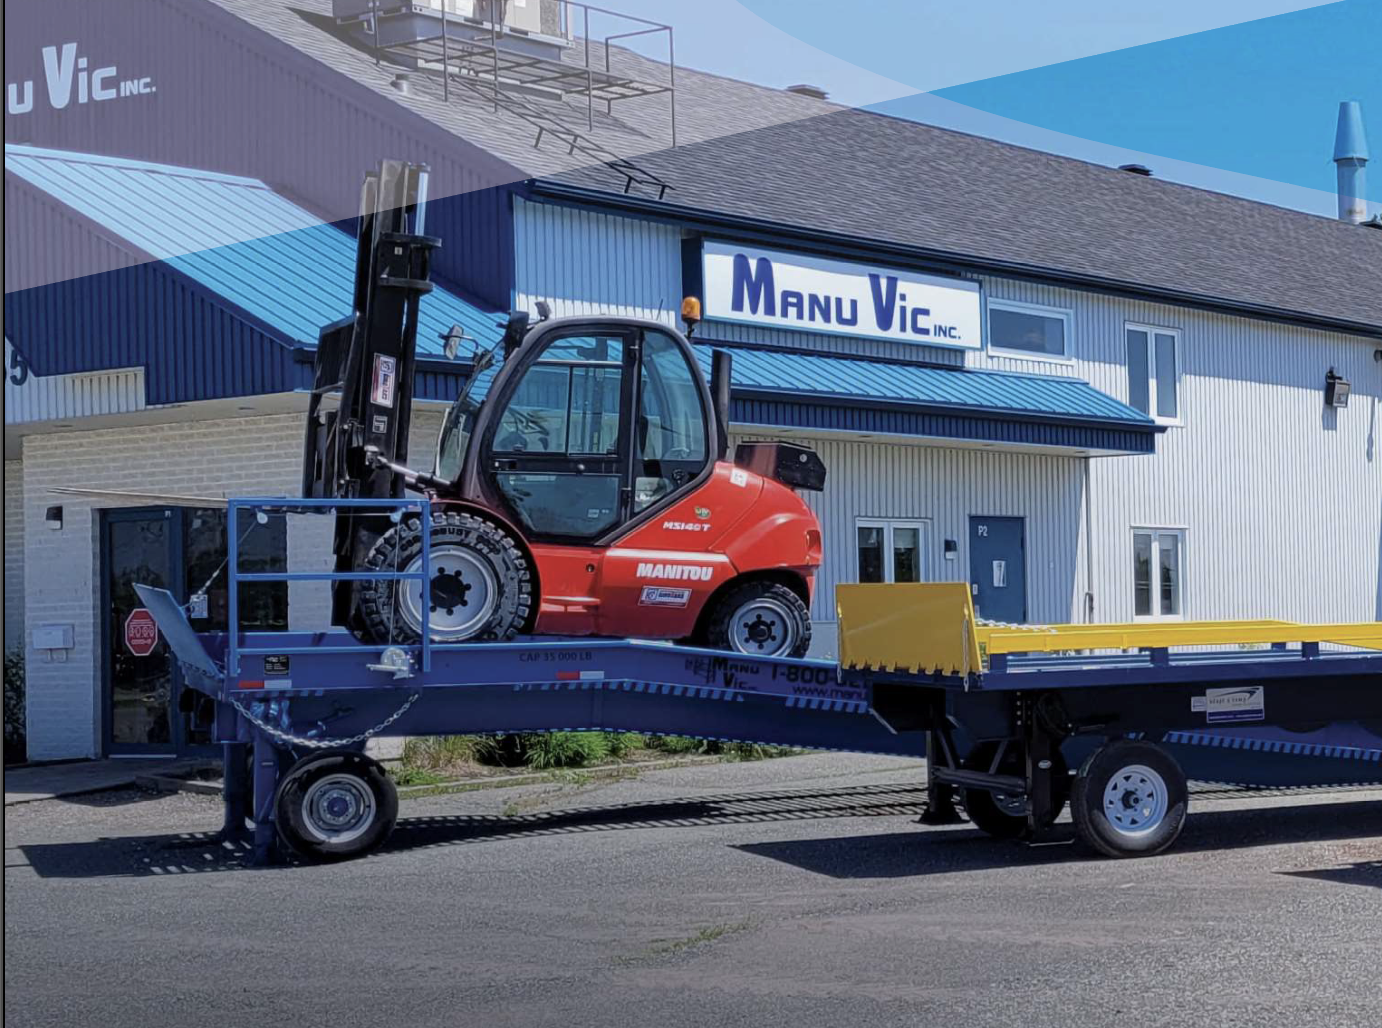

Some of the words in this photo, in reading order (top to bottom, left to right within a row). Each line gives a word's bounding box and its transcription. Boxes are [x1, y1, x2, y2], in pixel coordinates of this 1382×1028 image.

[933, 324, 962, 340] INC.
[978, 525, 988, 537] P2
[636, 563, 713, 581] MANITOU
